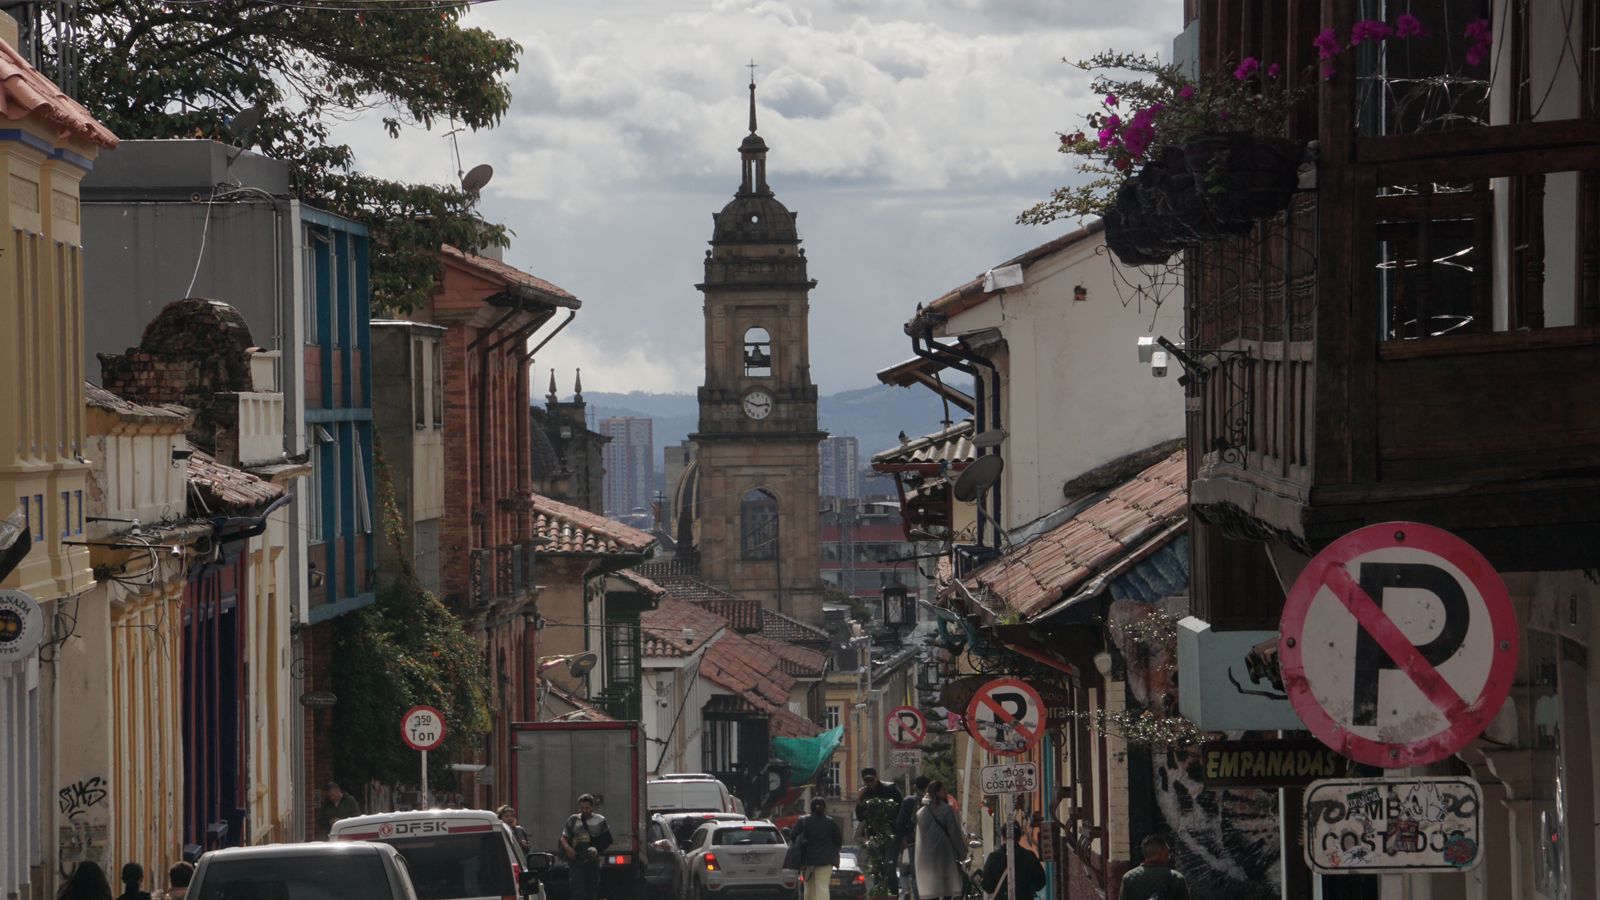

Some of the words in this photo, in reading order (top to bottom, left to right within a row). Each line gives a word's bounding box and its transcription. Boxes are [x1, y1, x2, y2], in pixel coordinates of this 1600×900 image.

[1352, 562, 1470, 726] P
[898, 712, 918, 742] P
[992, 692, 1027, 742] P
[411, 728, 434, 741] Ton
[1206, 750, 1337, 778] EMPANADAS
[986, 777, 1033, 790] COSTAS
[395, 821, 448, 834] DFSK
[1322, 830, 1466, 853] COSTDO
